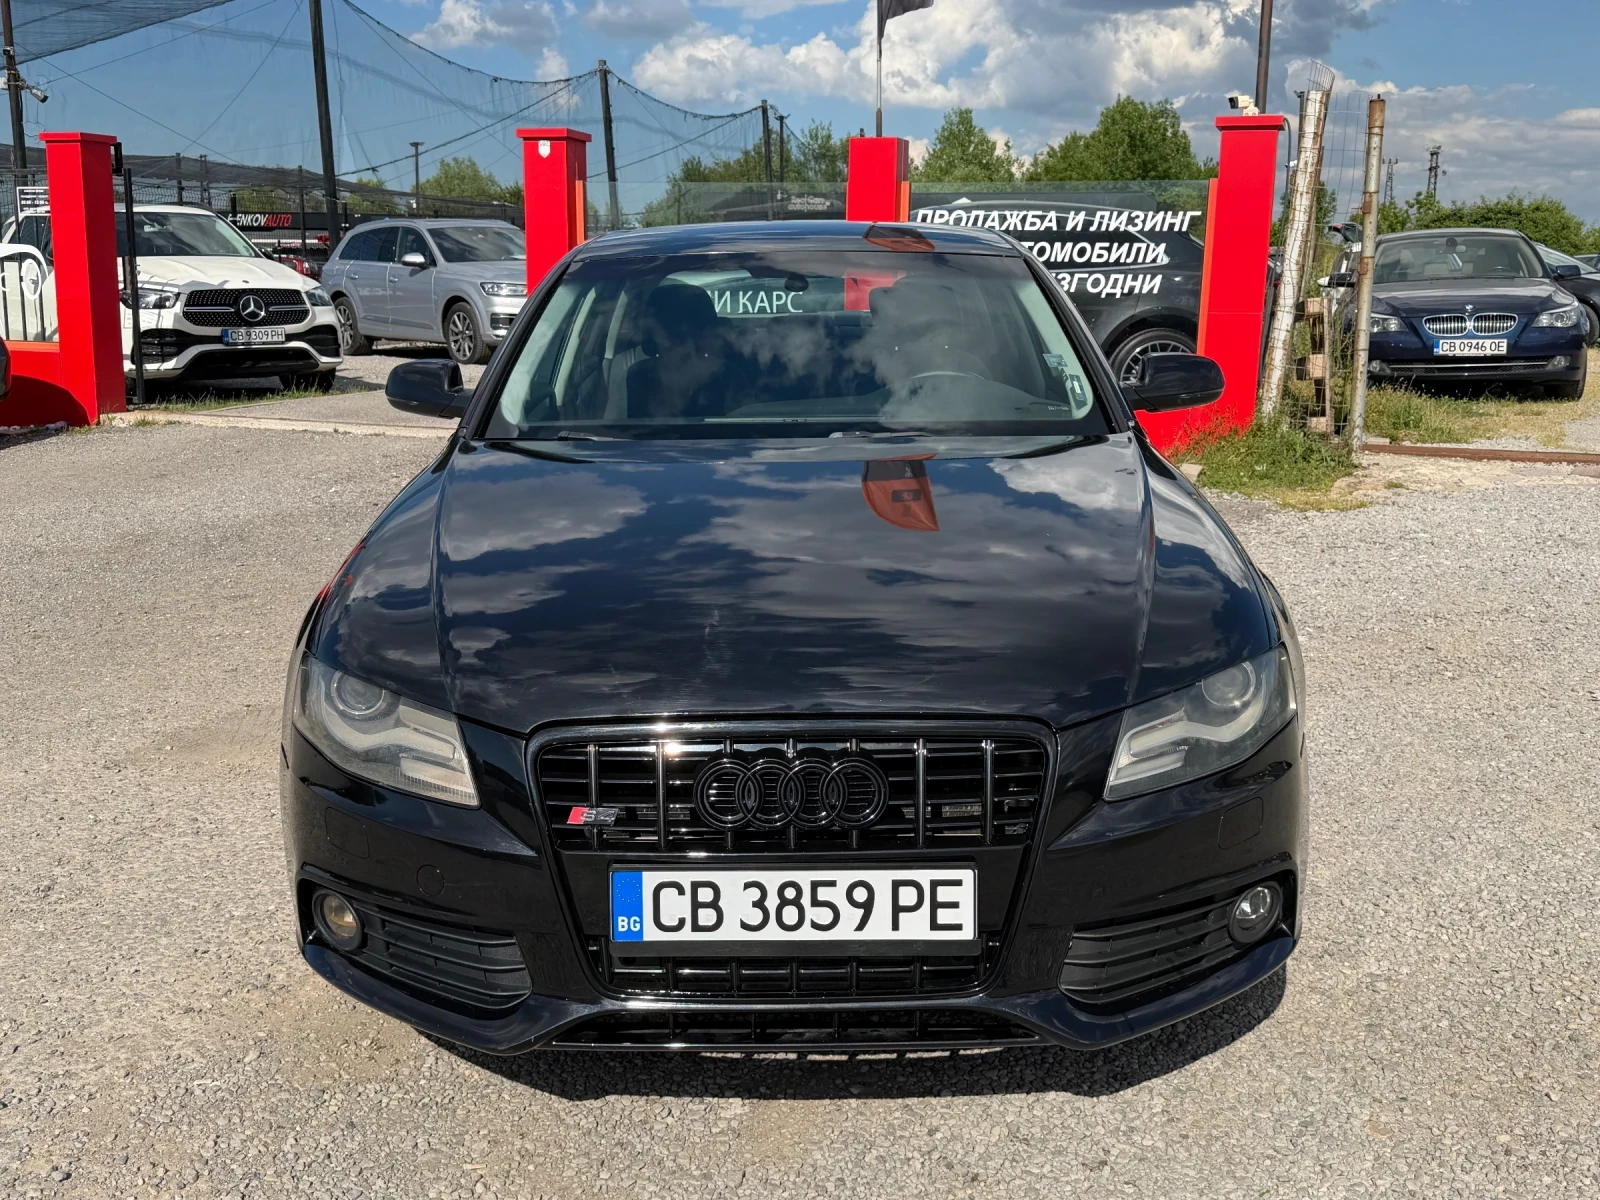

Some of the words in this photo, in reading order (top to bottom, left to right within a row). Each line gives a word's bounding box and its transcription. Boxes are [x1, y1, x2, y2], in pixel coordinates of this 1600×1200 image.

[1065, 210, 1084, 231] И
[1089, 210, 1202, 232] ЛИЗИНГ
[1051, 273, 1163, 298] ЗГОДНИ
[737, 290, 803, 314] КАРС
[230, 330, 244, 341] CB
[245, 330, 270, 341] 9309
[270, 329, 284, 340] PH
[1441, 341, 1456, 352] CB
[1458, 341, 1487, 352] 0946
[652, 880, 724, 933] CB
[739, 879, 876, 932] 3859
[891, 878, 963, 932] PE
[617, 916, 641, 932] BG
